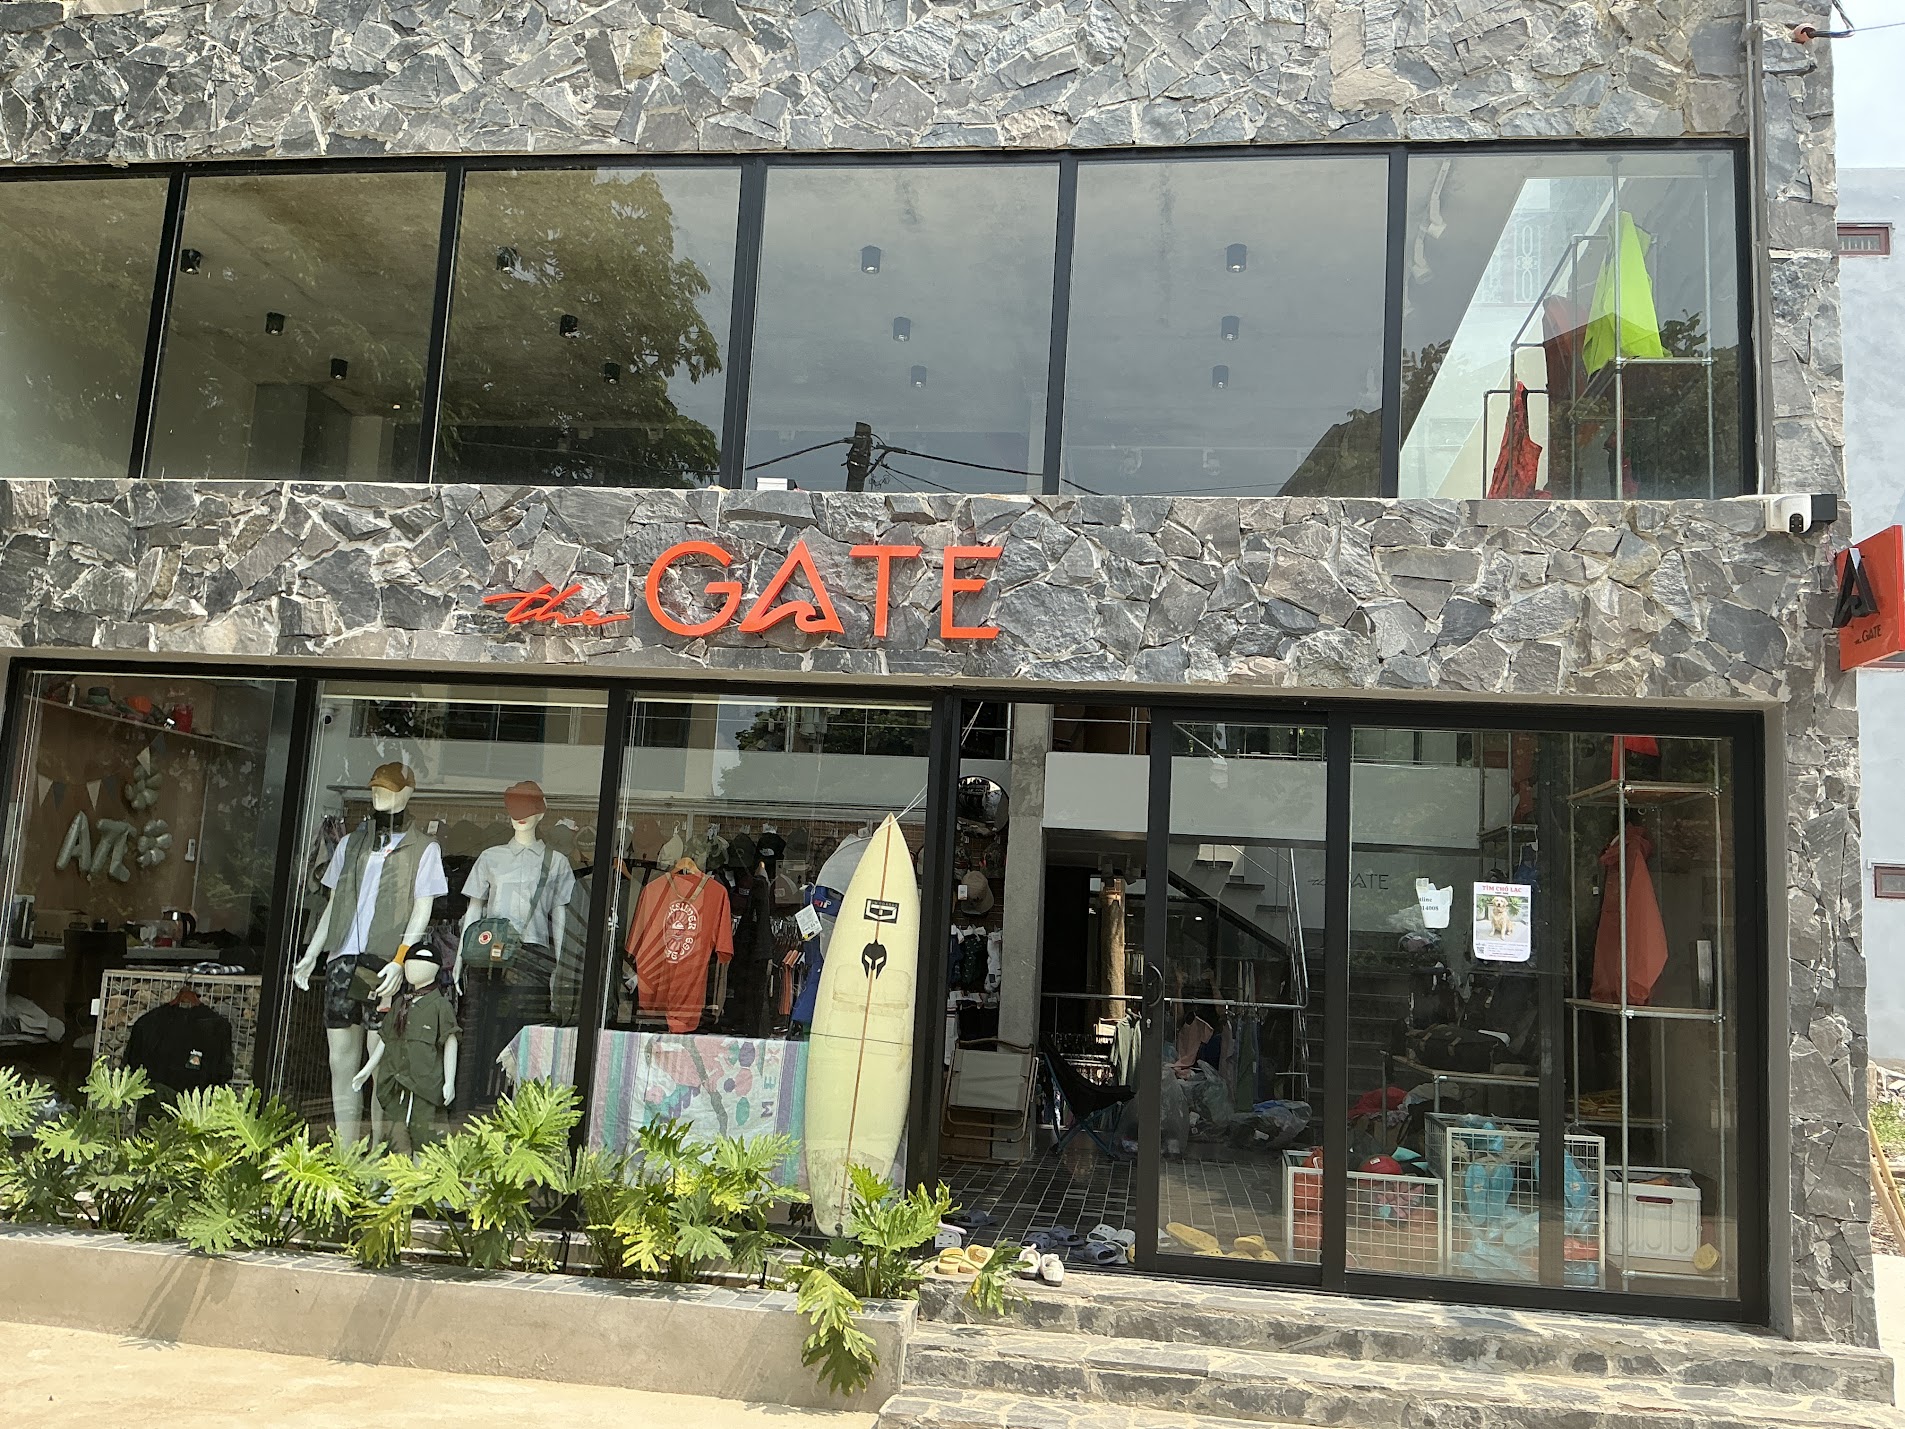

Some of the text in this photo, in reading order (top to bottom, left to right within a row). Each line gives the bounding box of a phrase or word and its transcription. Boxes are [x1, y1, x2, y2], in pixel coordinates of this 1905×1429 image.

[482, 540, 1003, 639] the GATE
[1862, 624, 1882, 643] GATE
[1351, 873, 1389, 890] ATE
